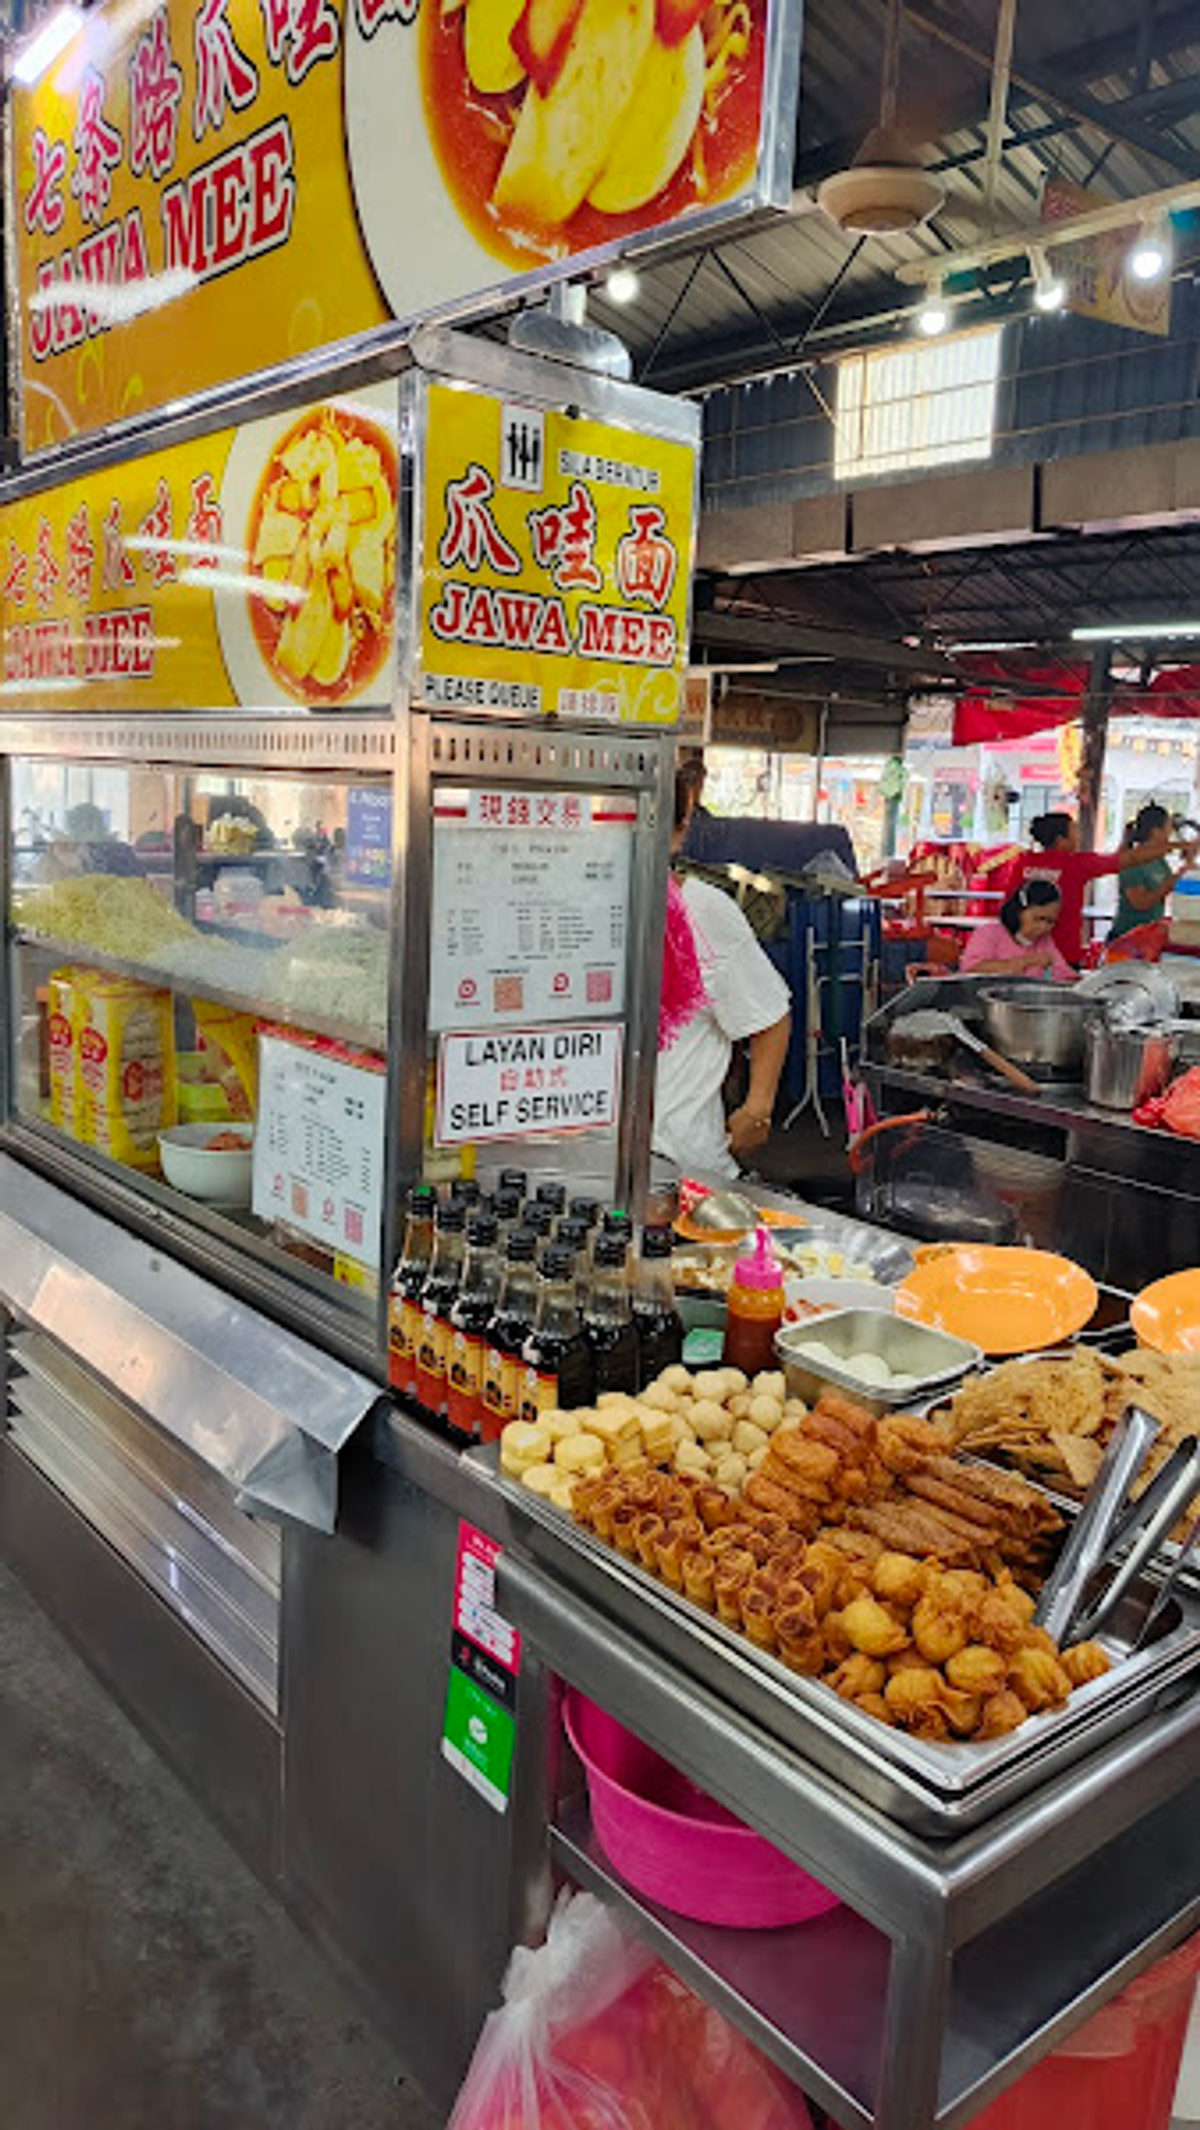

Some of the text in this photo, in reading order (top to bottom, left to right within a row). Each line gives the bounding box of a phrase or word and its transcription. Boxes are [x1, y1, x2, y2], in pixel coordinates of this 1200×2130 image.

[163, 116, 295, 284] MEE
[439, 463, 677, 612] 爪哇面
[82, 603, 154, 682] MEE
[430, 580, 678, 667] JAWA MEE
[425, 674, 539, 708] PLEASE QUEUE
[465, 1032, 602, 1067] LAYAN DIRI
[450, 1090, 609, 1131] SELF SERVICE
